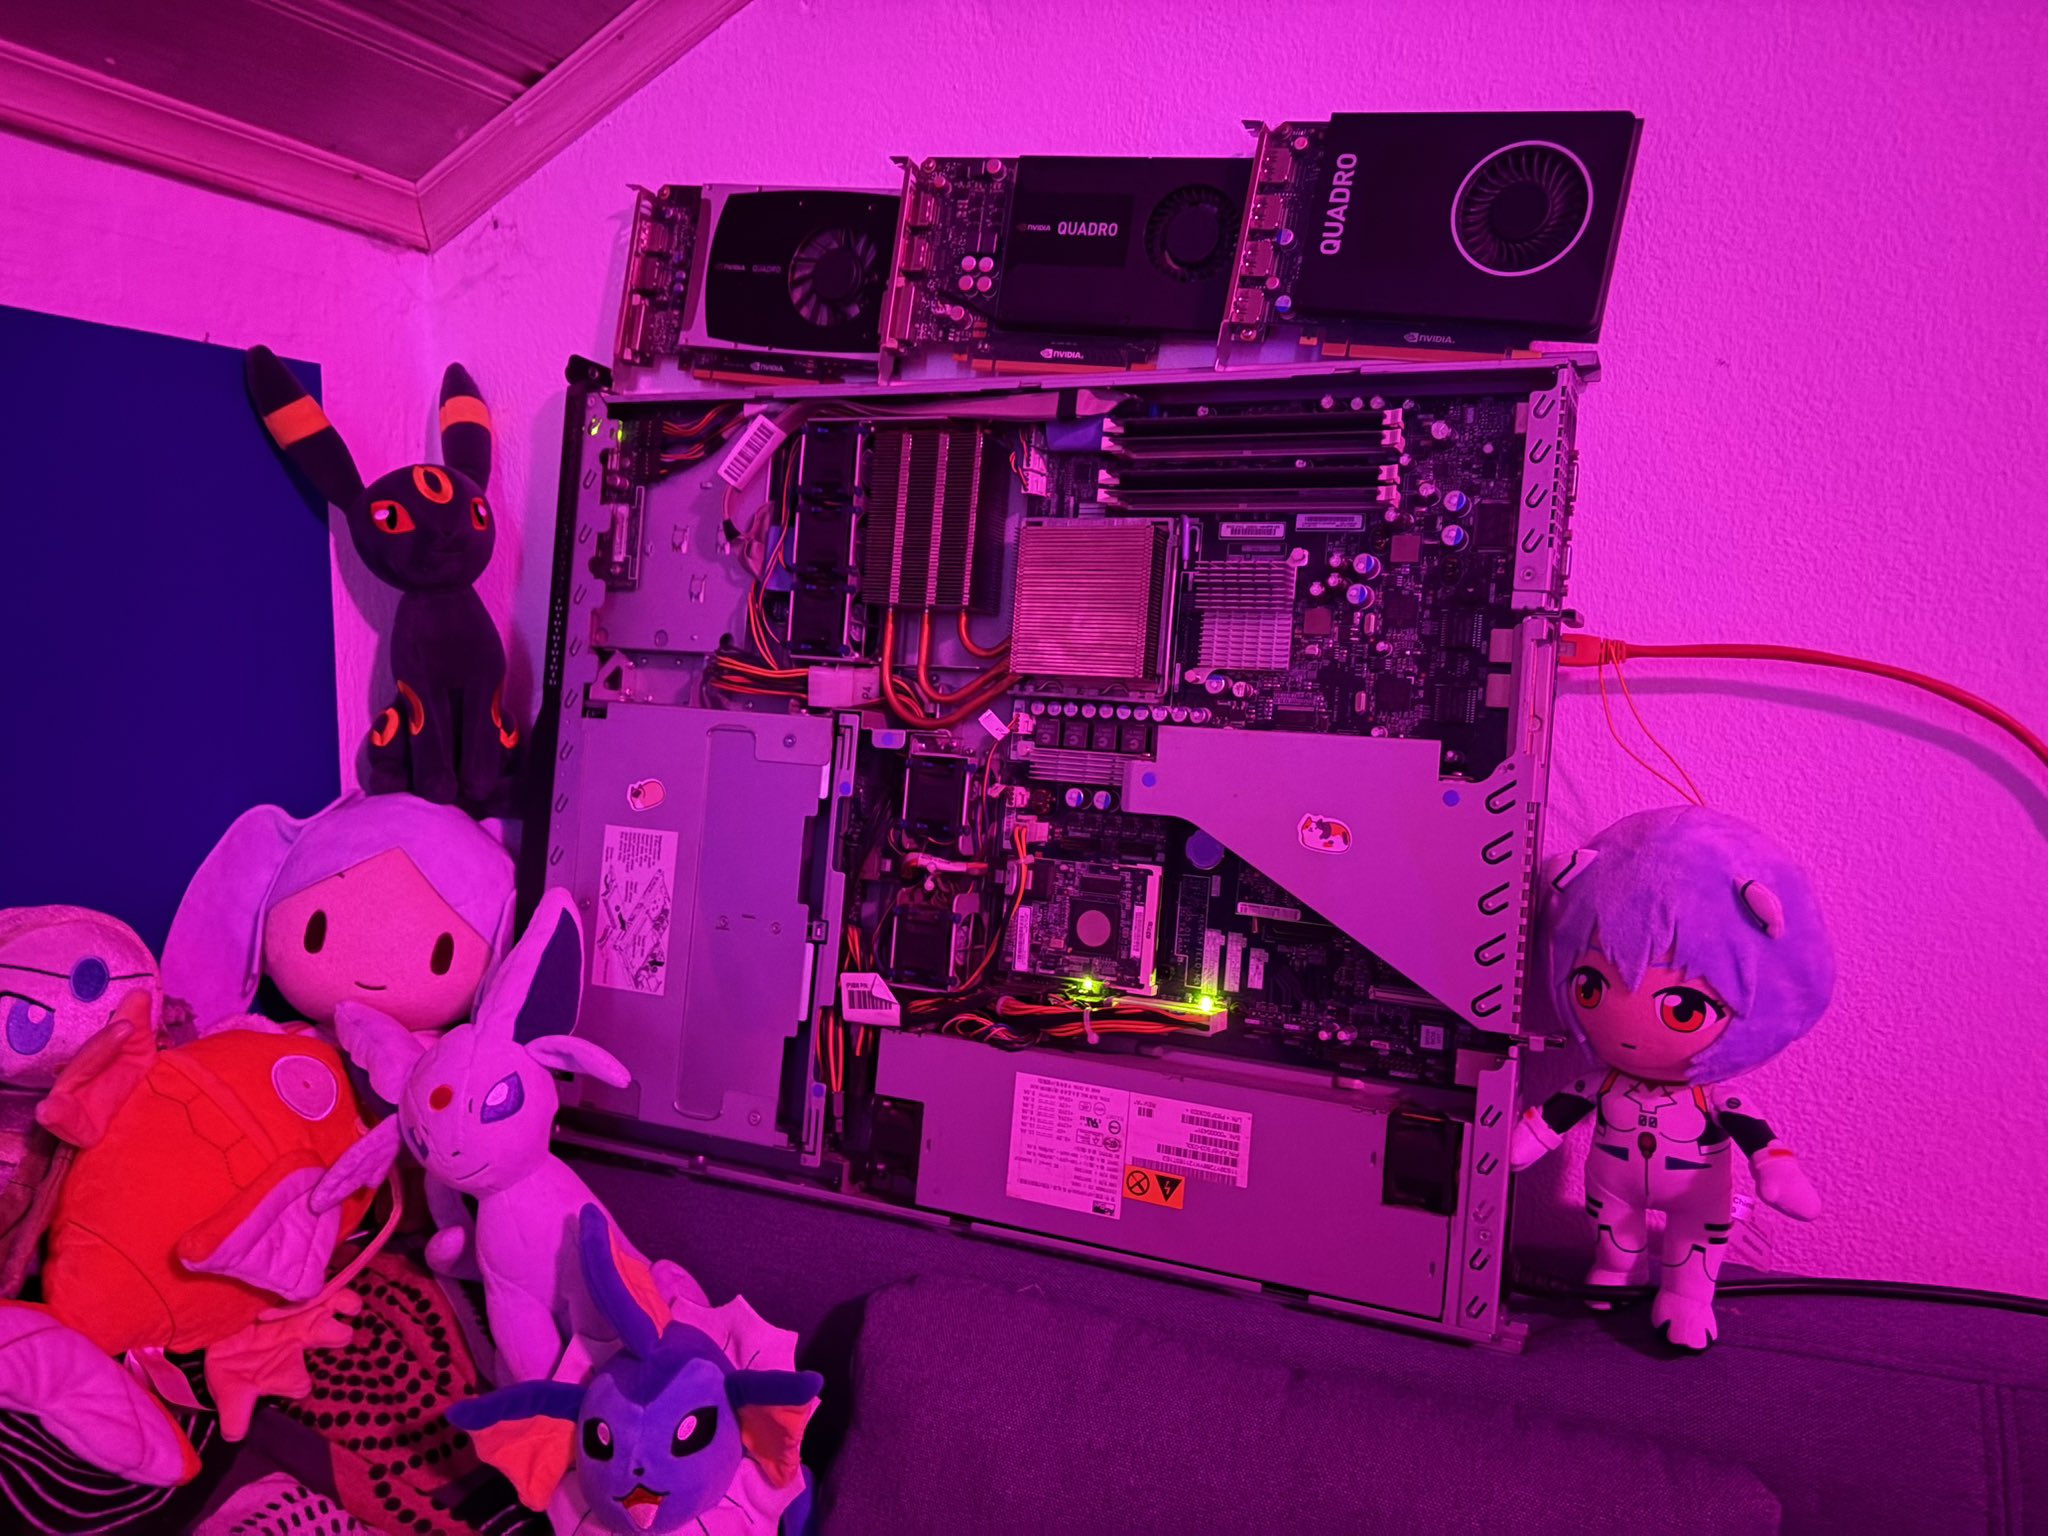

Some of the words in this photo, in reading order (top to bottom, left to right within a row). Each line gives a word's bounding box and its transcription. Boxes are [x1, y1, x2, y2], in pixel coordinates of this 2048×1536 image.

[1320, 153, 1358, 255] QUADRO
[1027, 223, 1051, 232] NVIDIA
[1057, 221, 1118, 237] QUADRO
[1418, 334, 1450, 344] NVIDIA
[1053, 350, 1078, 359] NVIDIA
[861, 686, 873, 701] P4
